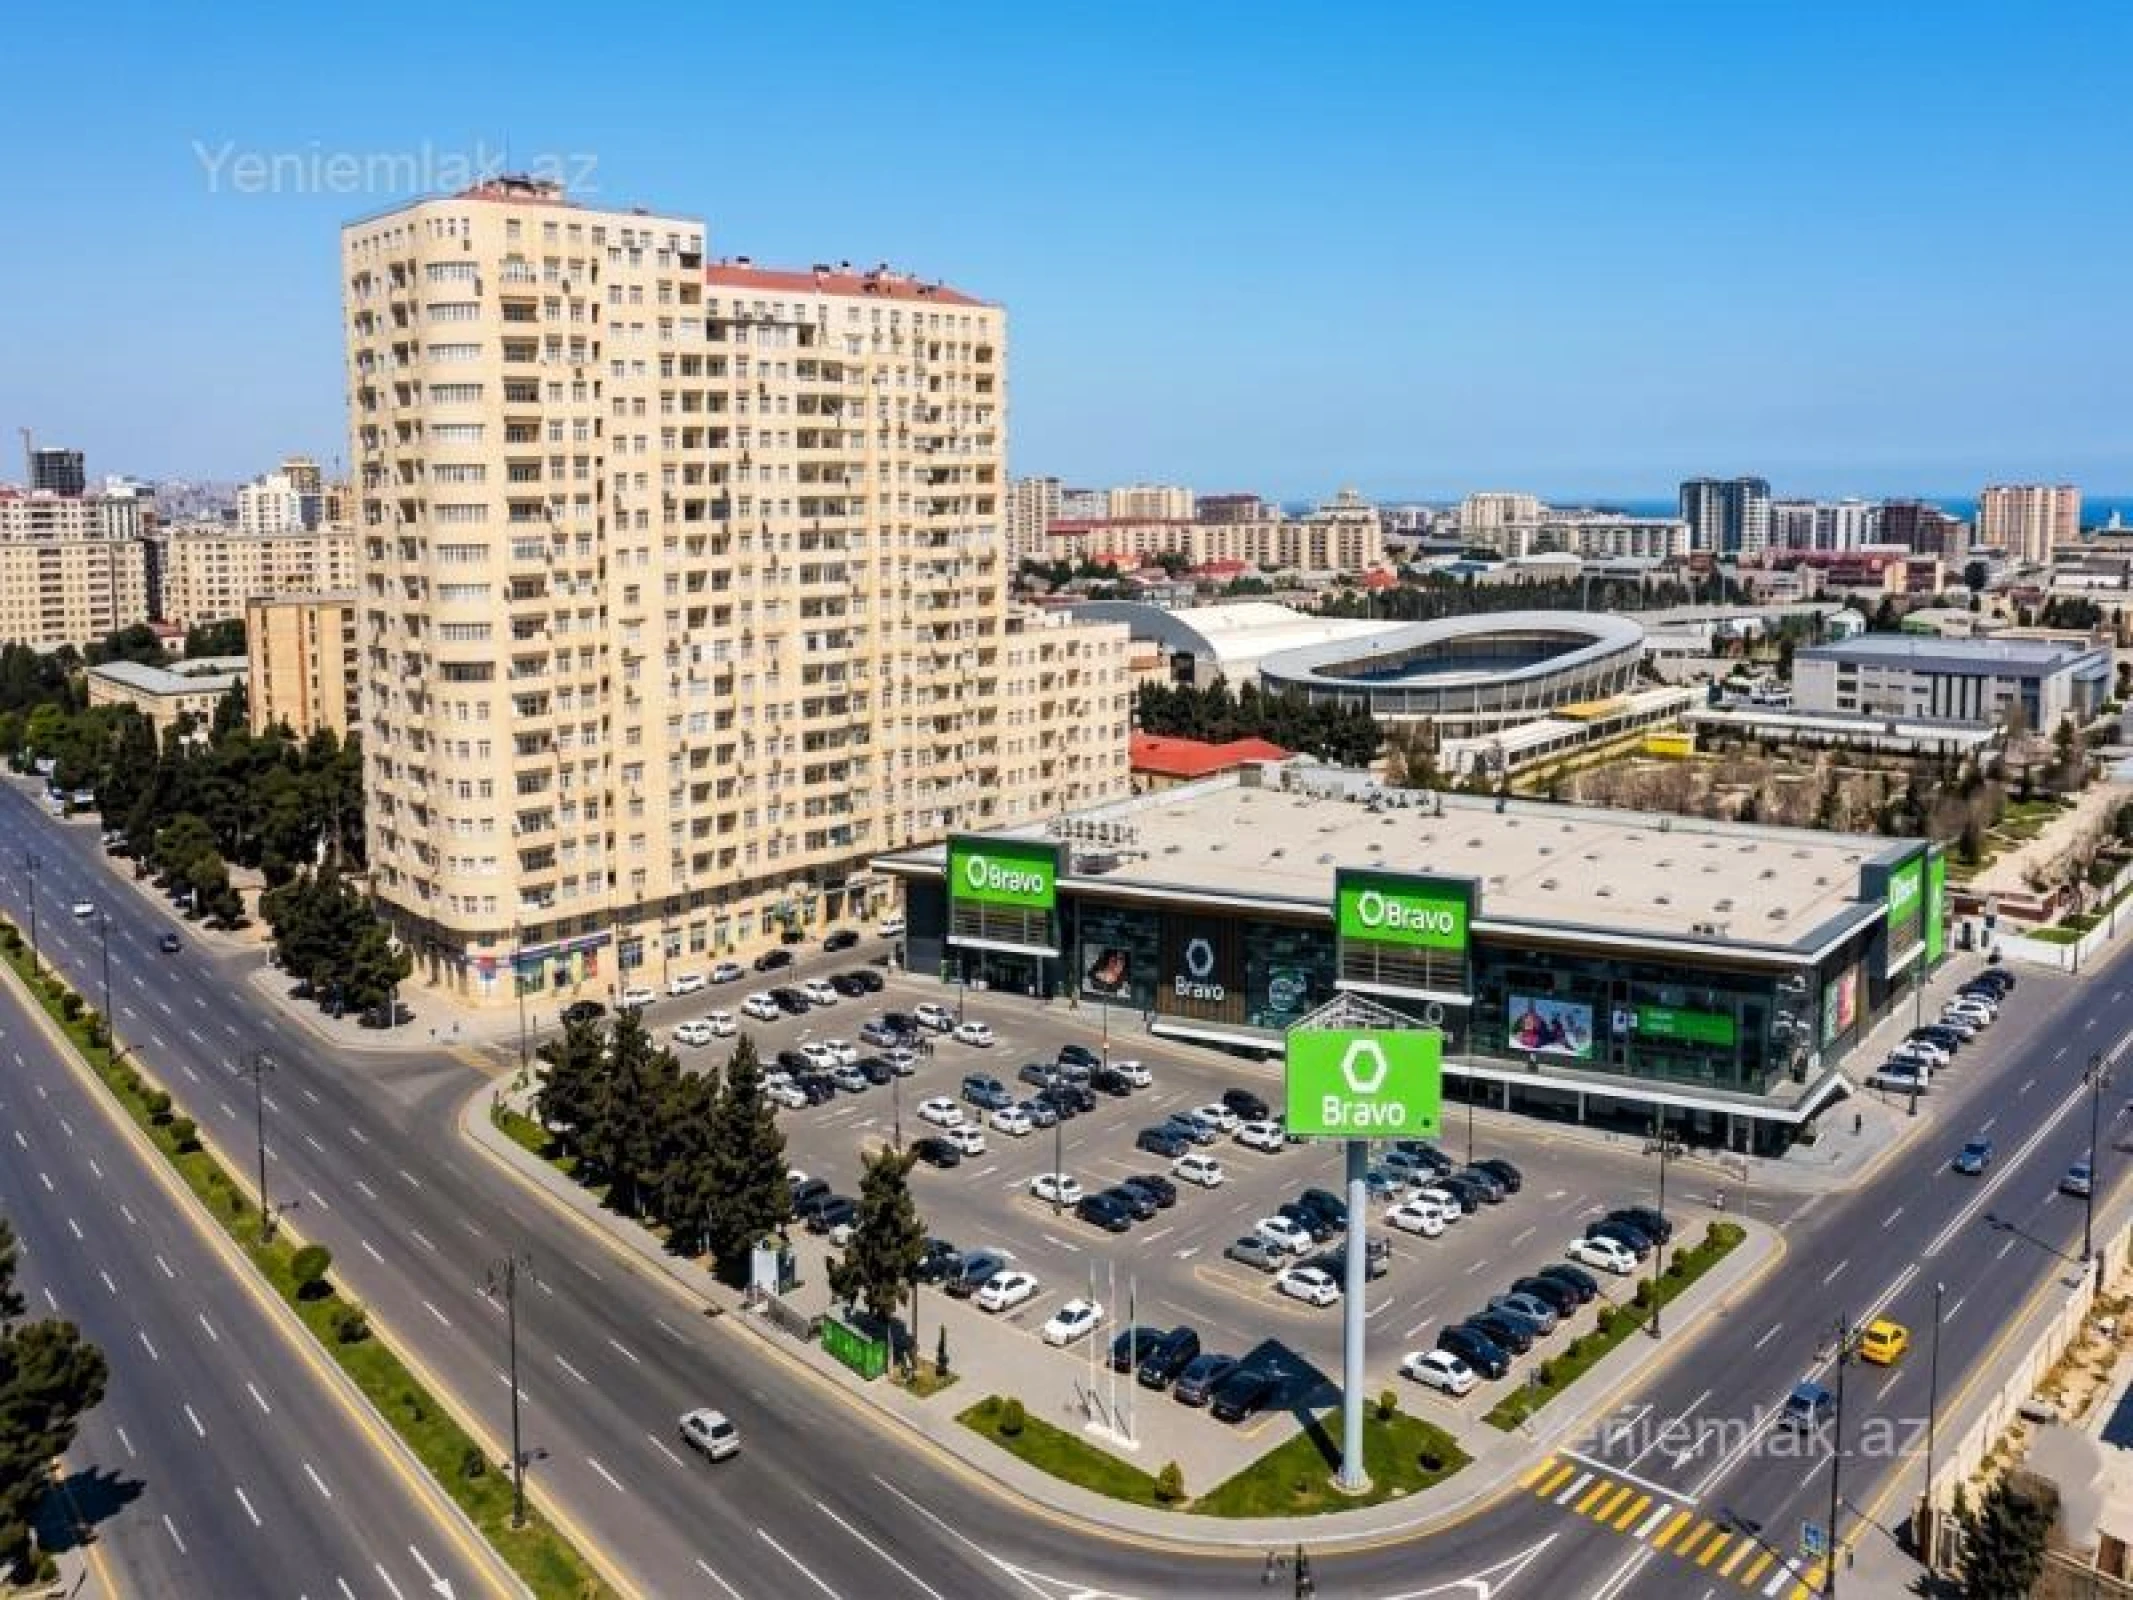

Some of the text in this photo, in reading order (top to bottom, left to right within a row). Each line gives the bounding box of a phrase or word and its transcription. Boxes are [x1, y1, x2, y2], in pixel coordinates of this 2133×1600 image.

[988, 864, 1043, 892] Bravo
[1386, 902, 1454, 934] Bravo
[1175, 972, 1225, 1001] Bravo
[1322, 1095, 1406, 1127] Bravo
